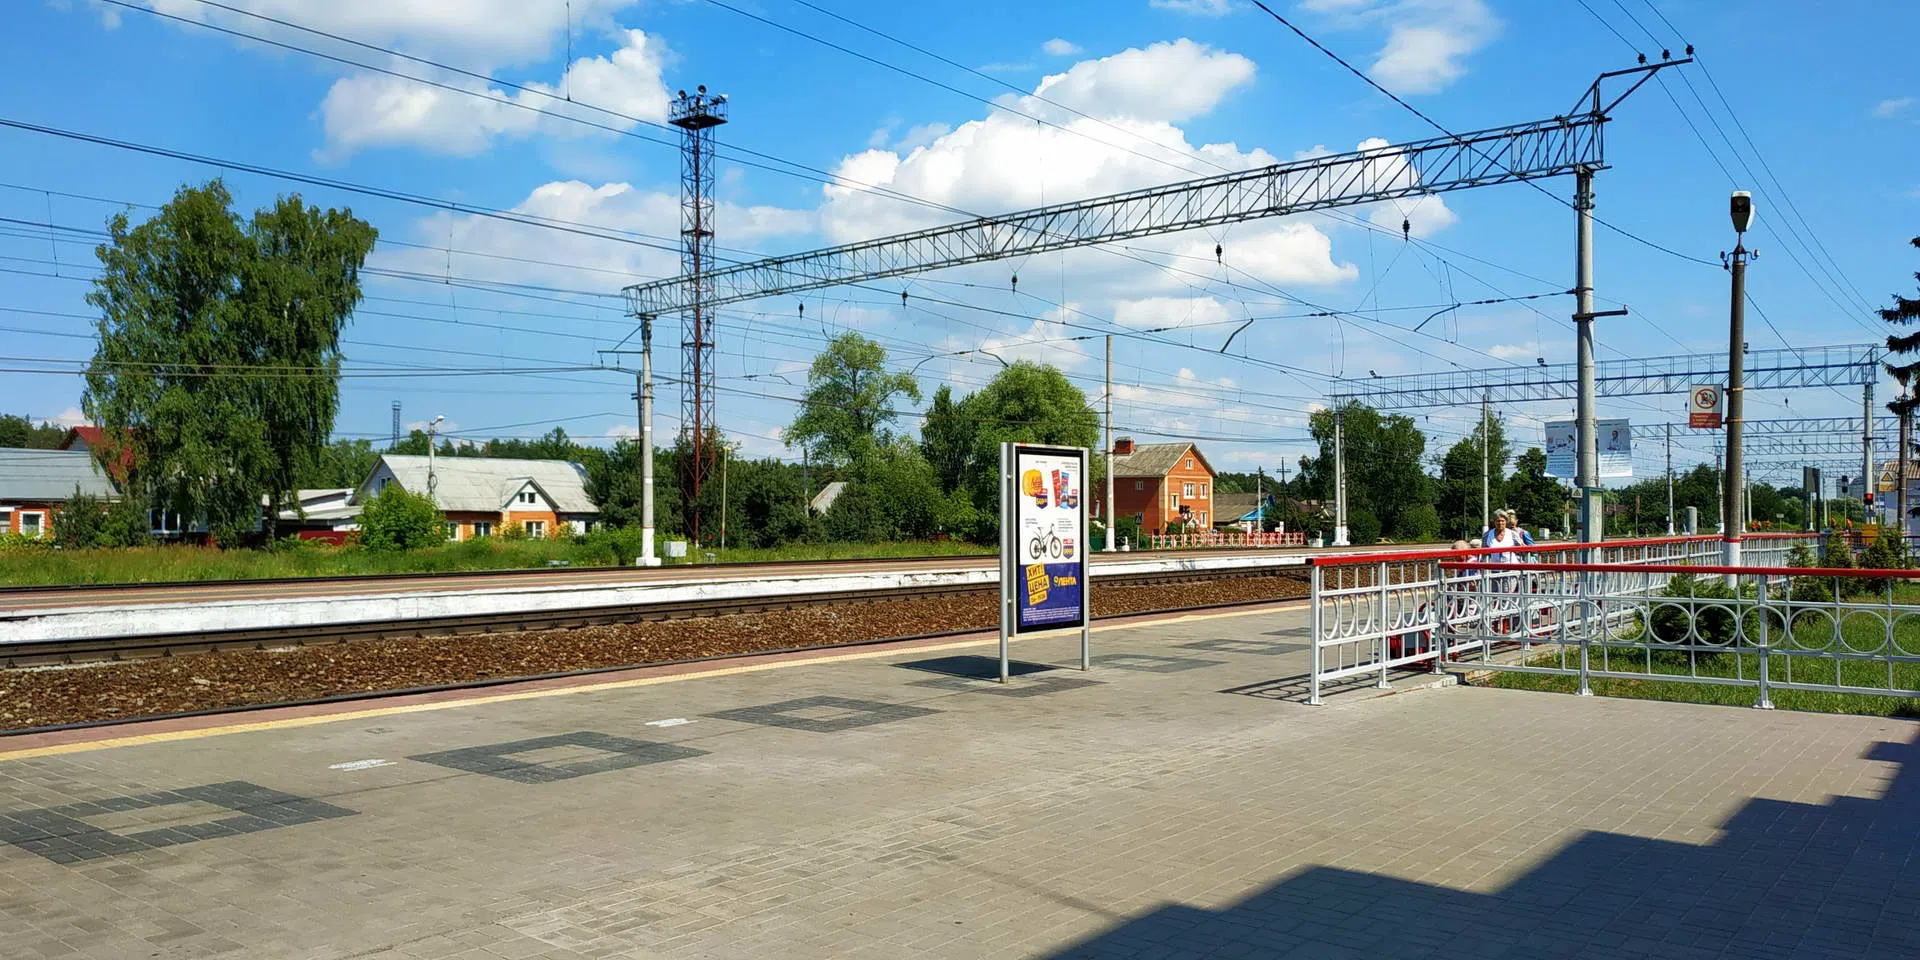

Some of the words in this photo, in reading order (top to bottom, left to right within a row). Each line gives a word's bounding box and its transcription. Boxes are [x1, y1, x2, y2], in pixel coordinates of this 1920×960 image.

[1028, 564, 1044, 578] ХИТ!
[1029, 577, 1048, 593] ЦЕНА
[1058, 576, 1077, 587] ЛЕНТА
